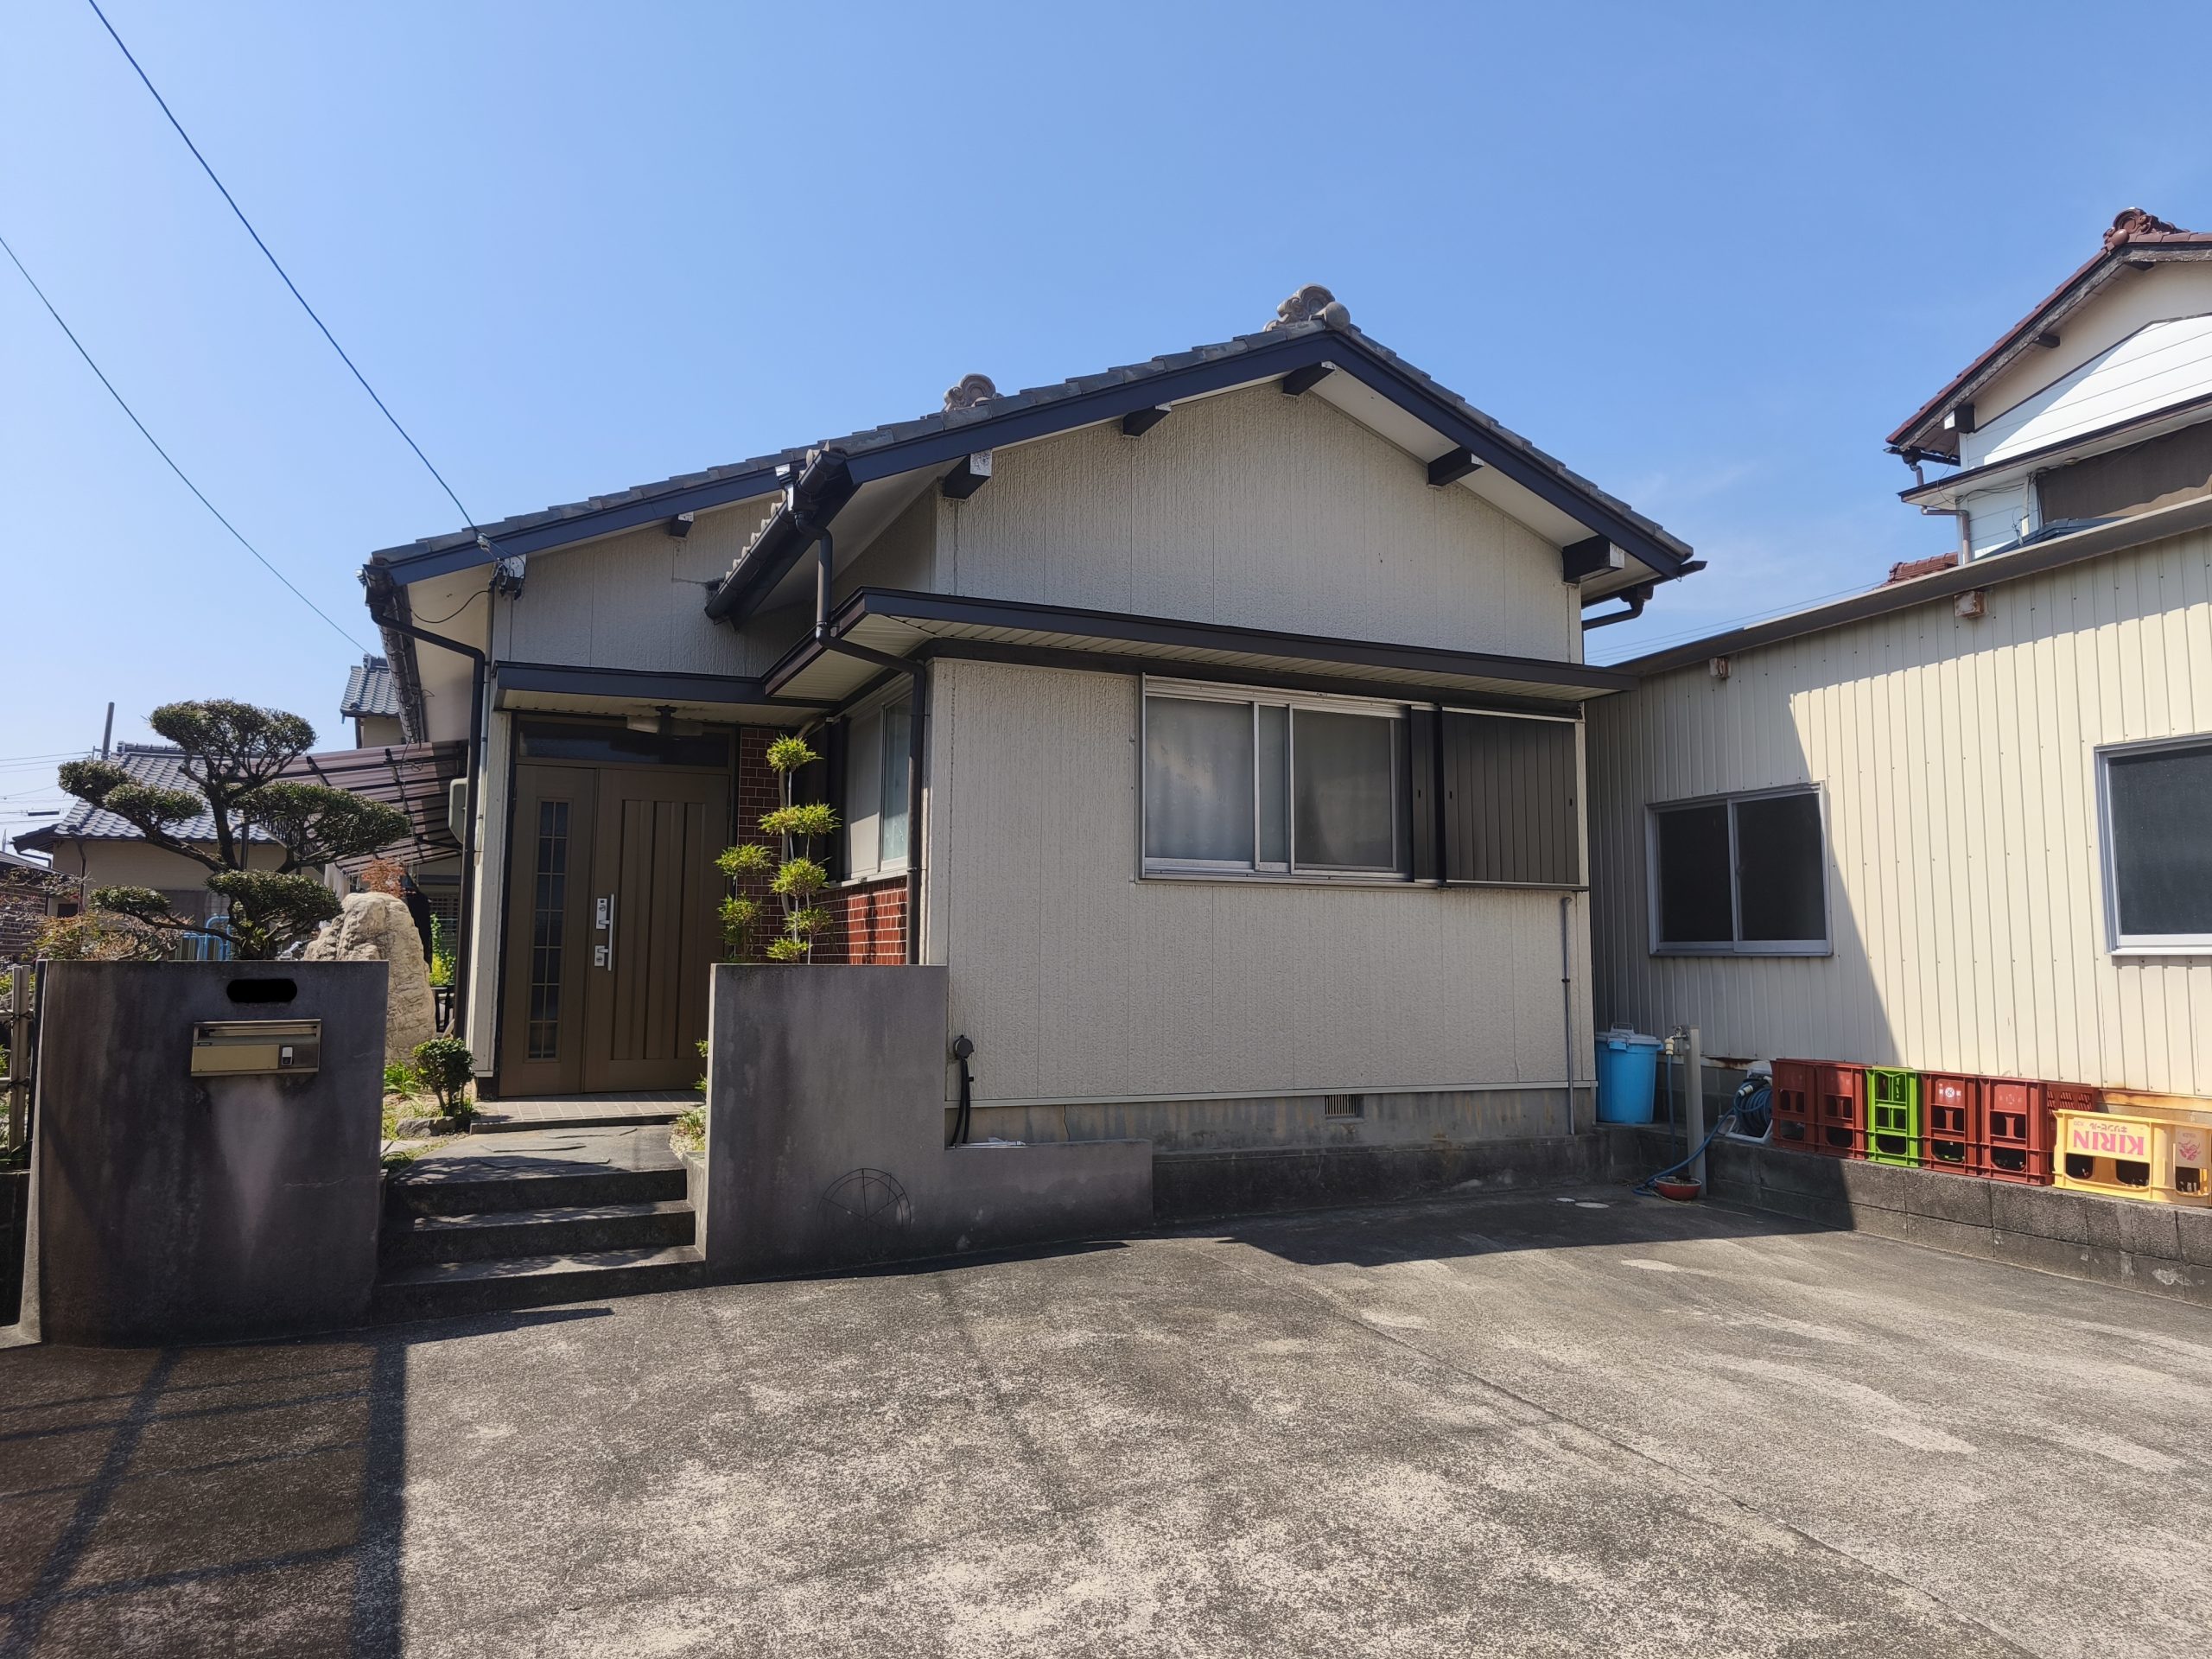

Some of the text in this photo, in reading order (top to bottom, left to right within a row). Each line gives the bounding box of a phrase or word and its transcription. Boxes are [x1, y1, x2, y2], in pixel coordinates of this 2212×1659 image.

[2089, 1122, 2127, 1133] キリンビール
[2074, 1130, 2144, 1155] KIRIN
